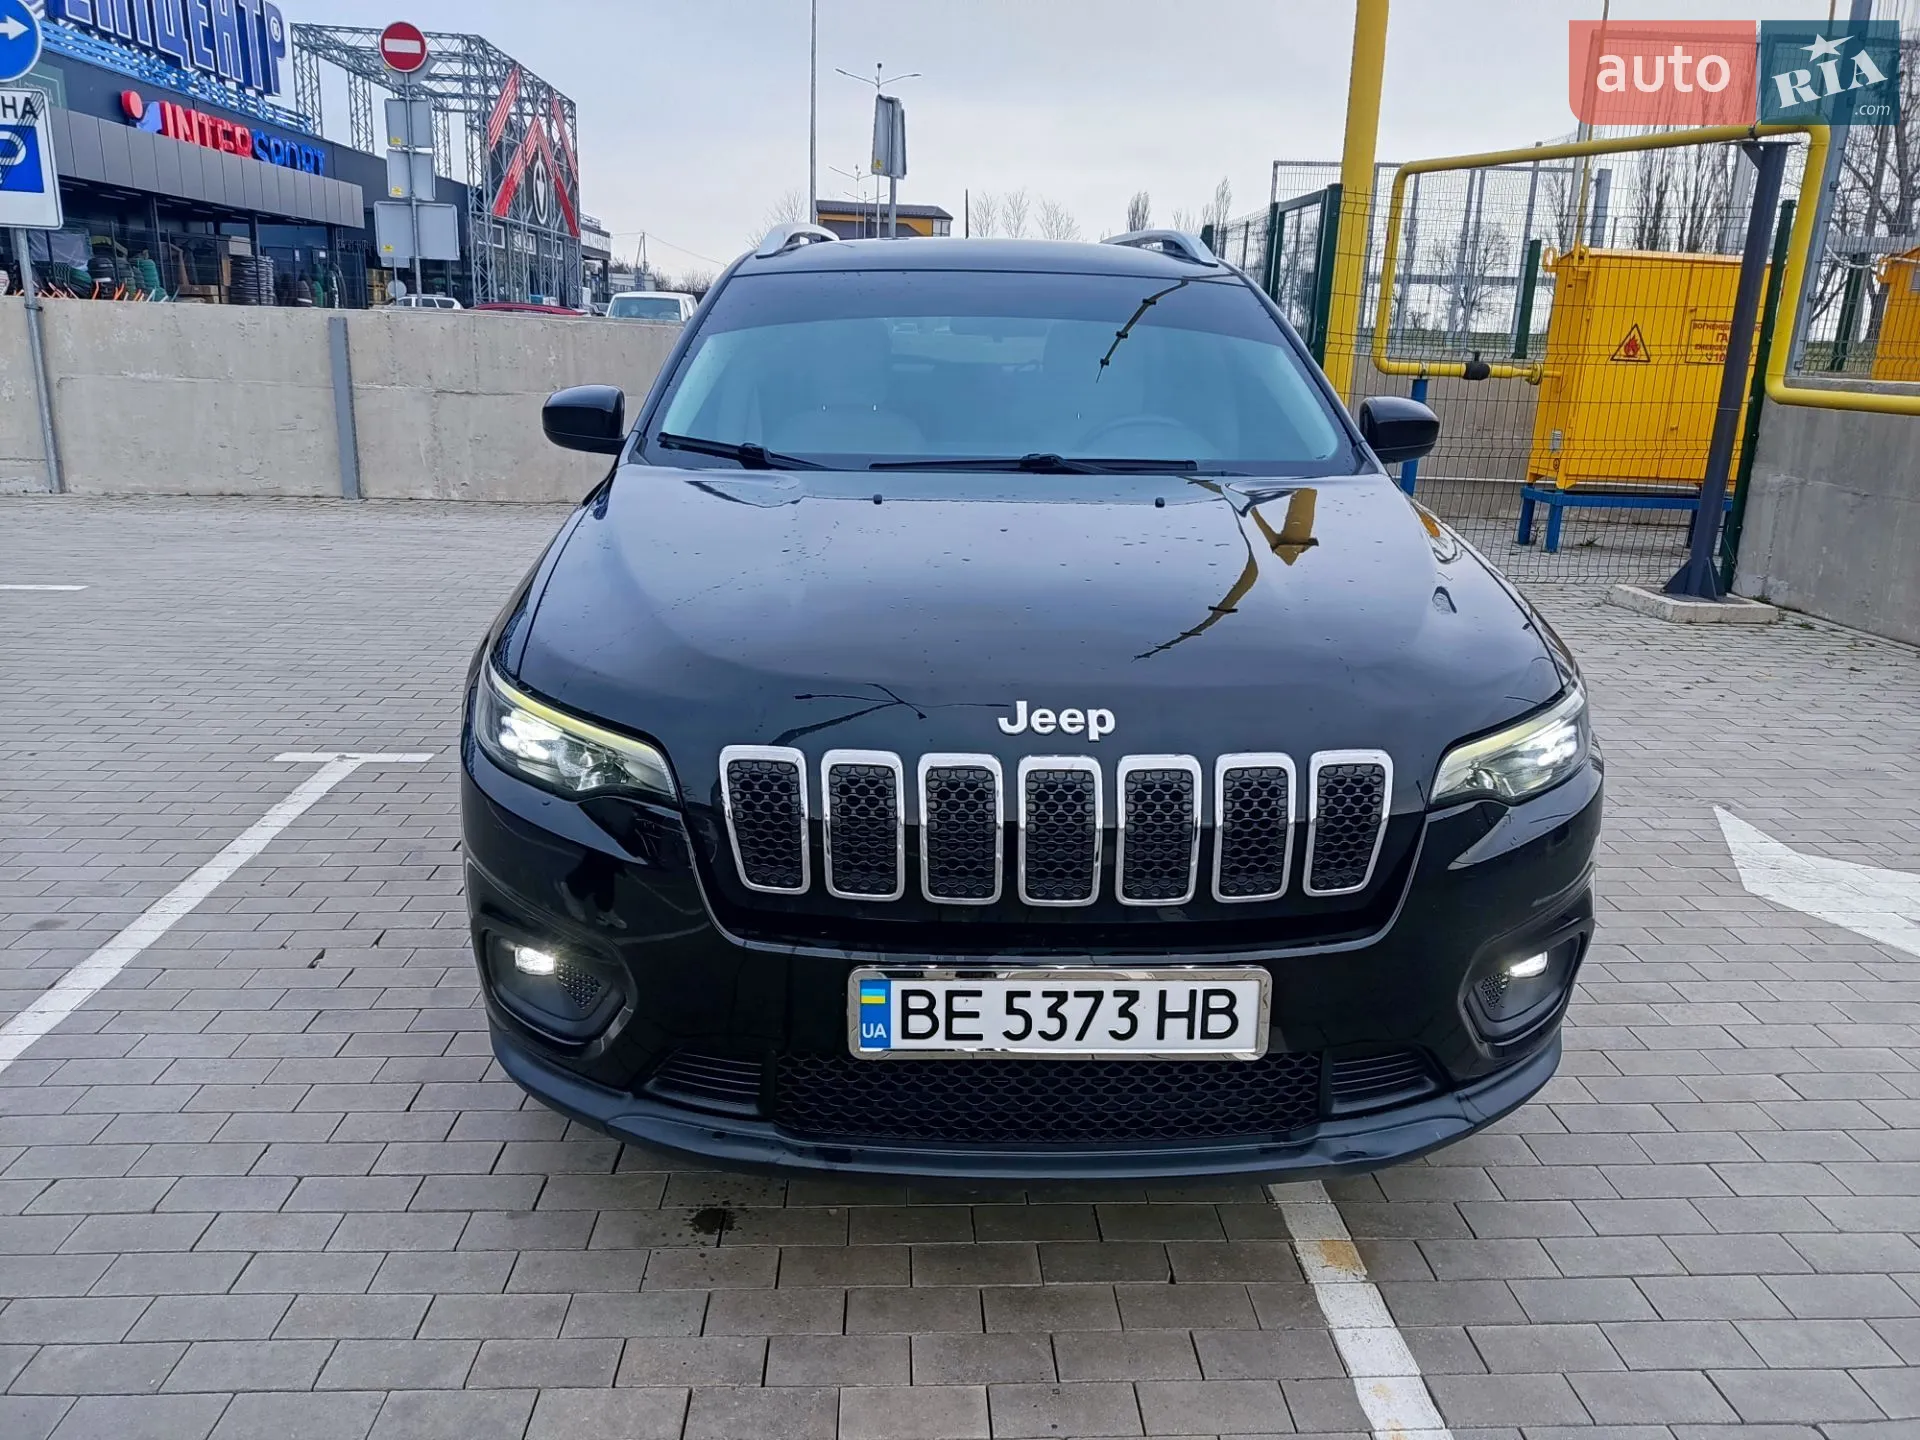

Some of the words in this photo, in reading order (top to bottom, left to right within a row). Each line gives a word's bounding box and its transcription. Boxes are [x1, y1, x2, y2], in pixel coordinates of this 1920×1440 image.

[158, 100, 326, 177] INTERSPORT
[998, 700, 1116, 741] Jeep
[862, 1022, 888, 1039] UA
[901, 989, 984, 1041] BE
[1001, 989, 1140, 1042] 5373
[1156, 988, 1239, 1041] HB
